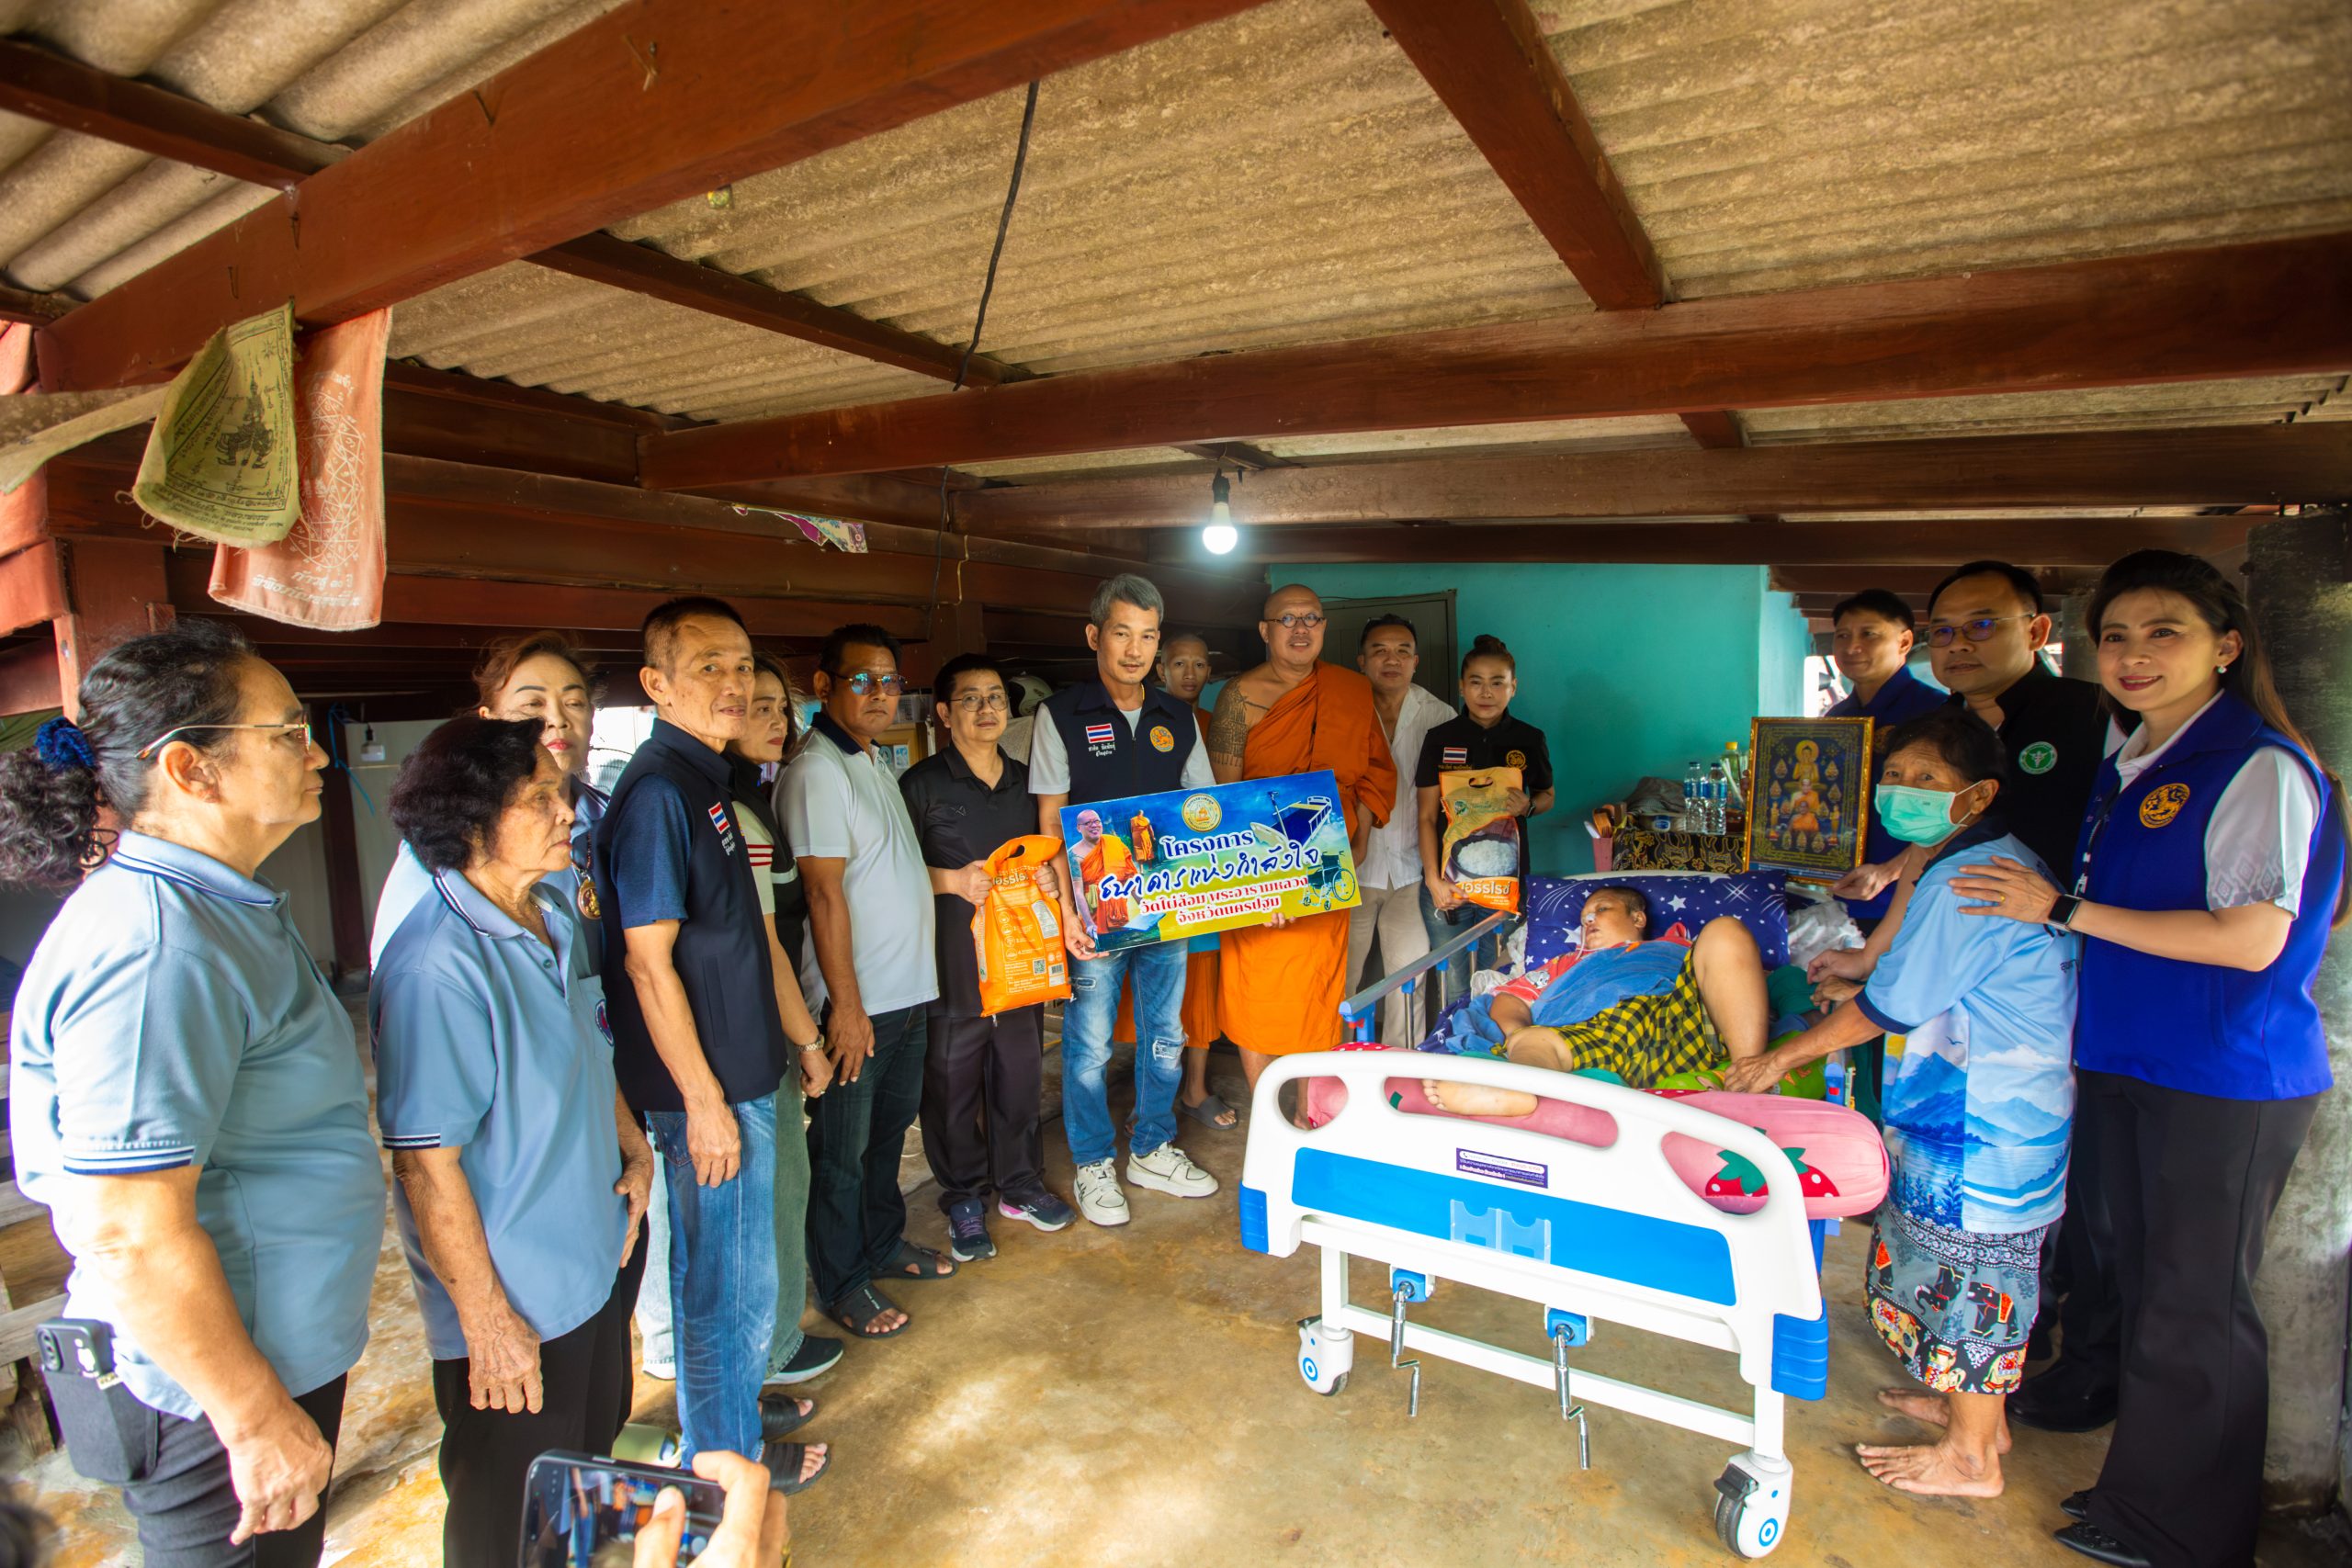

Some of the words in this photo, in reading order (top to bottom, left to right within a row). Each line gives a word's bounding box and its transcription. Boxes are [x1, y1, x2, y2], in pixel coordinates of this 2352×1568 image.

[1161, 831, 1254, 857] โครงการ
[1141, 894, 1206, 913] วัดไผ่ล้อม
[1208, 877, 1309, 900] พระอารามหลวง
[1179, 897, 1281, 922] จังหวัดนครปฐม
